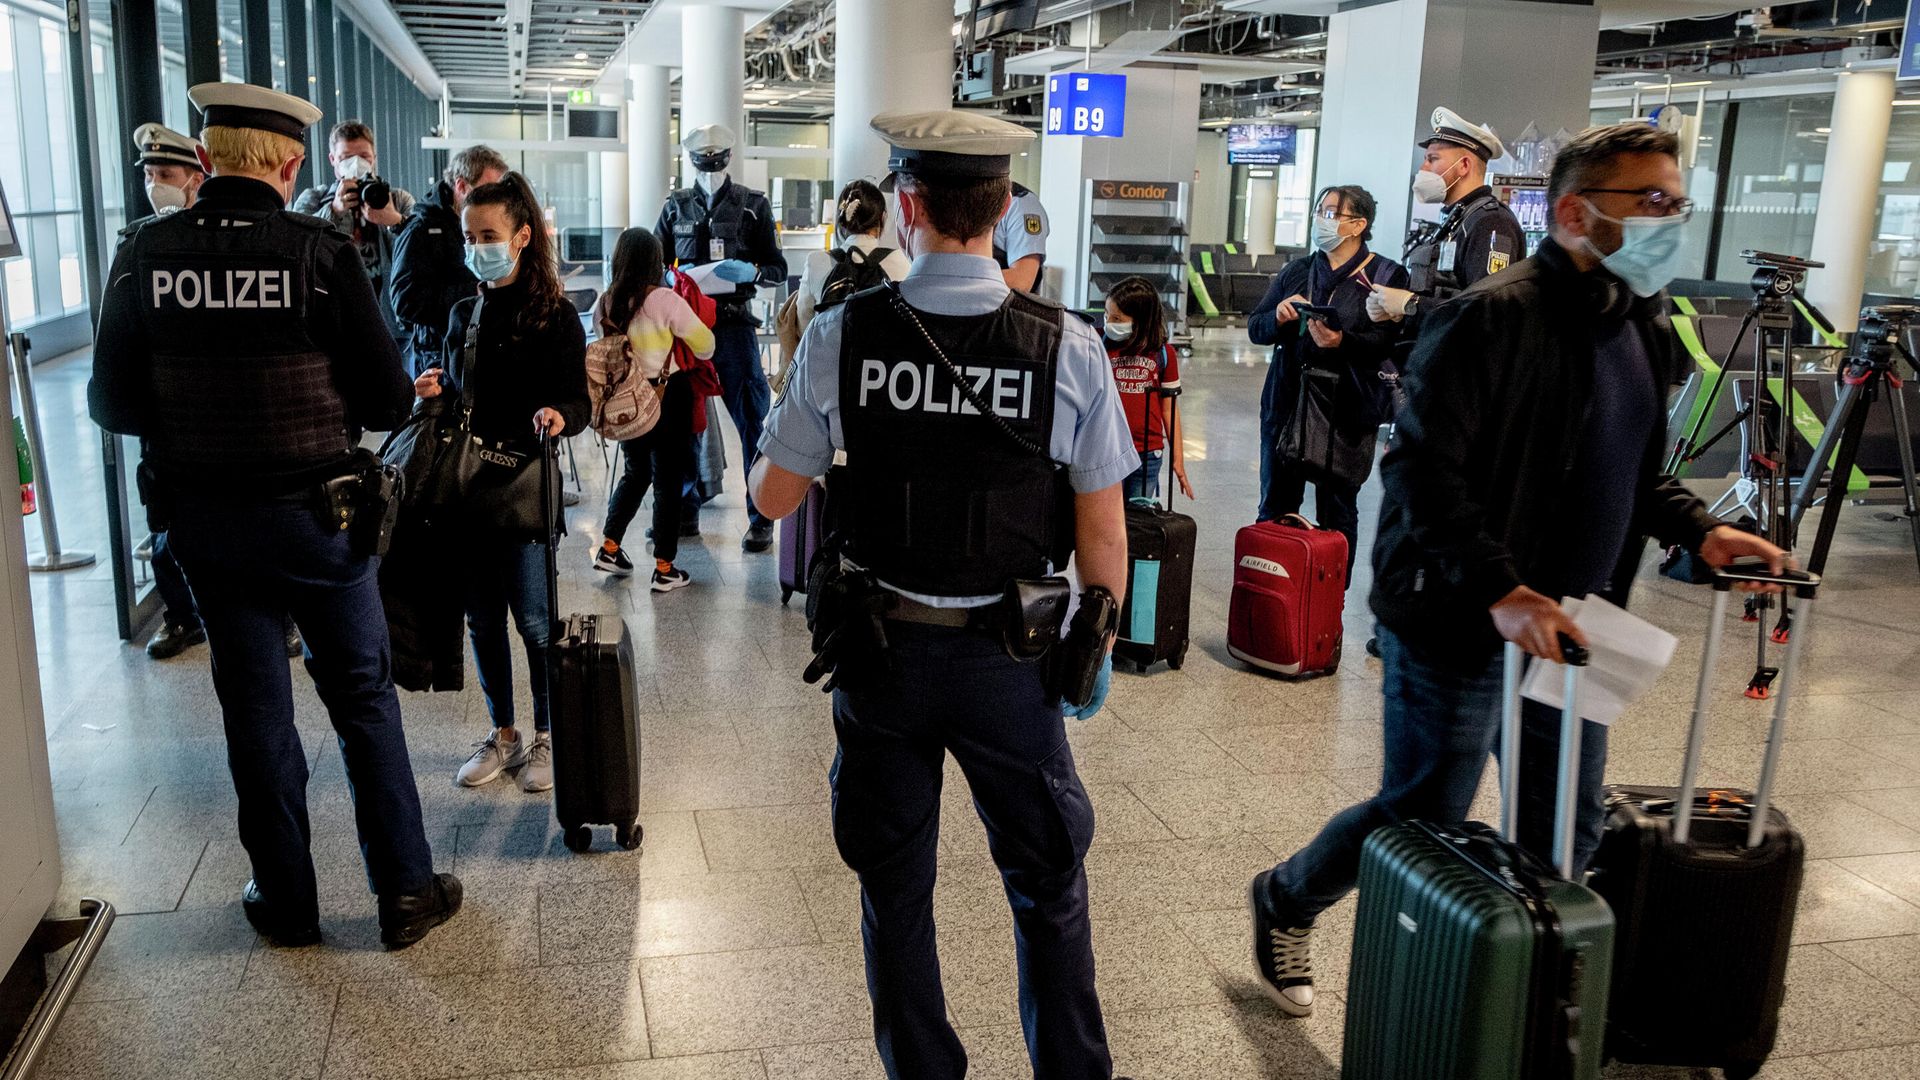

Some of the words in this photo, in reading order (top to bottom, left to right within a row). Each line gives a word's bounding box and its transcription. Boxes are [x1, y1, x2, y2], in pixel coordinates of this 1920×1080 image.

[1048, 107, 1062, 131] B9
[1073, 106, 1104, 132] B9
[1119, 184, 1168, 199] Condor
[152, 269, 291, 309] POLIZEI
[1111, 356, 1157, 371] STRONG
[1116, 369, 1149, 380] GIRLS
[859, 359, 1033, 420] POLIZEI
[480, 449, 518, 468] GUESS
[1246, 559, 1278, 572] AIRFIELD
